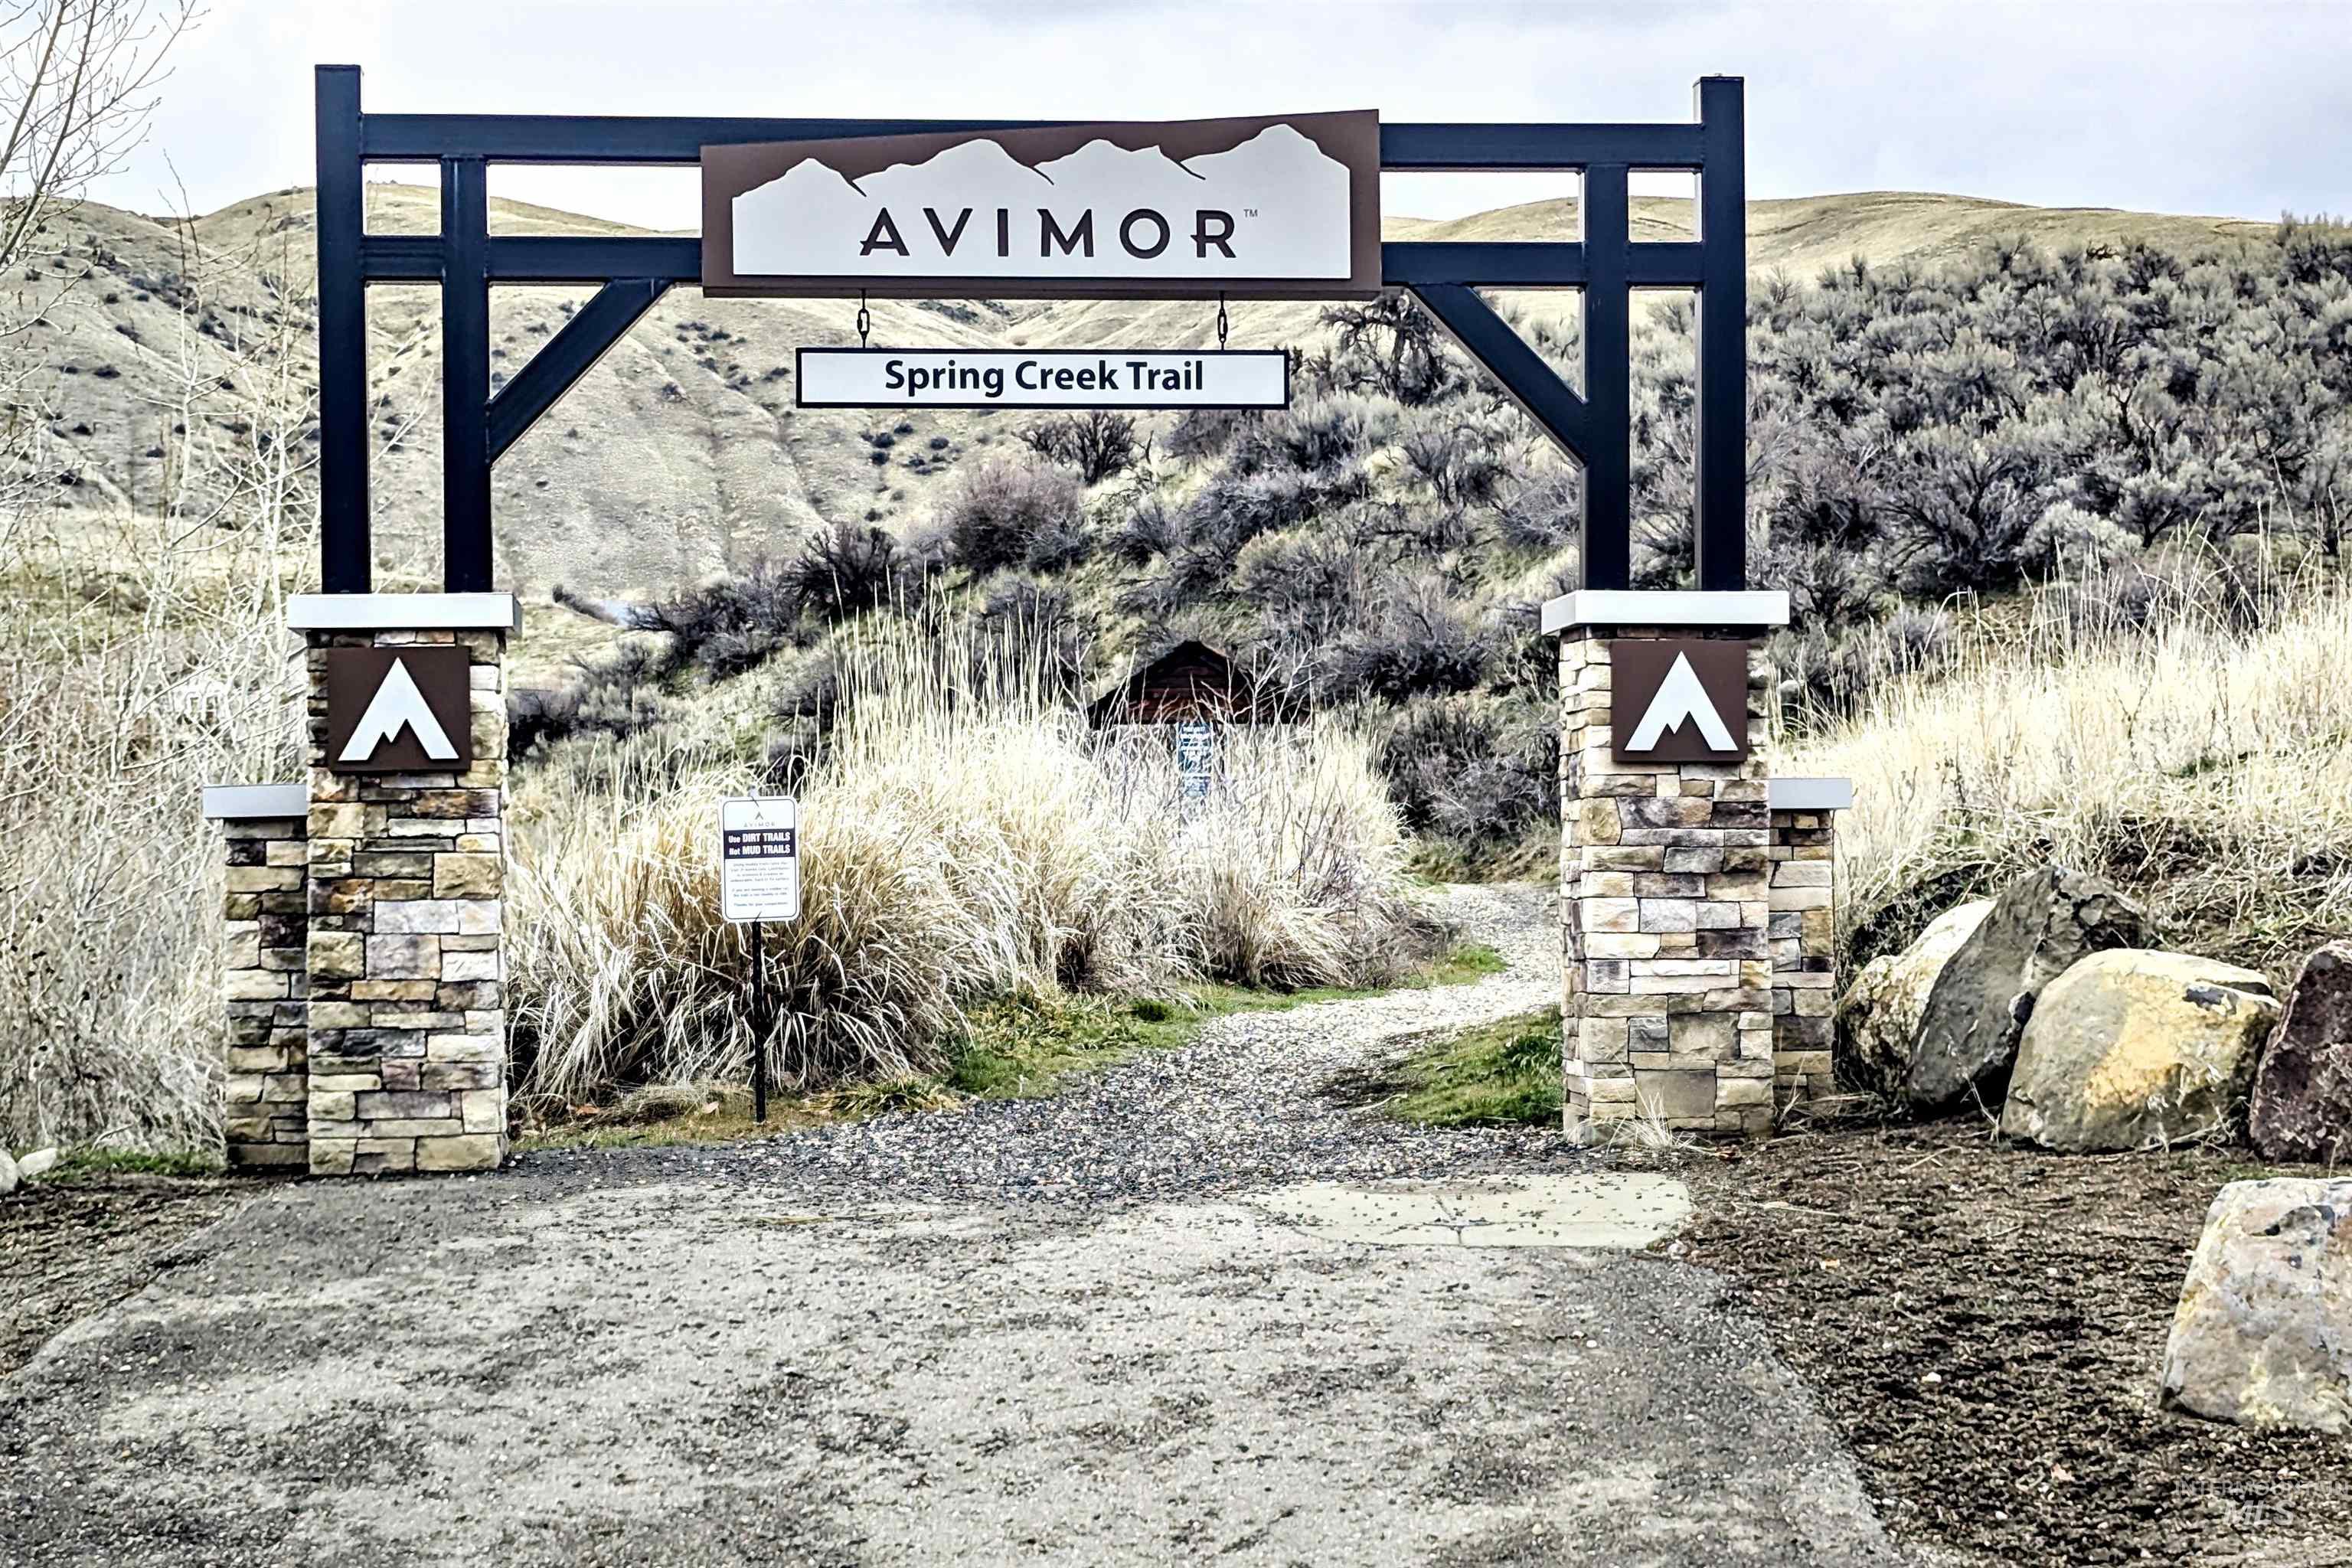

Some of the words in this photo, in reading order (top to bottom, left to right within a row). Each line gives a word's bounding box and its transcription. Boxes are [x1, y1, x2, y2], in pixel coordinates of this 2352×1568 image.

[859, 207, 1237, 260] AVIMOR
[884, 359, 1004, 398] Spring
[1015, 360, 1119, 390] Creek
[1125, 360, 1203, 390] Trail
[743, 833, 761, 843] DIRT
[763, 832, 791, 841] TRAILS
[743, 845, 761, 854] MUD
[763, 844, 791, 854] TRAILS
